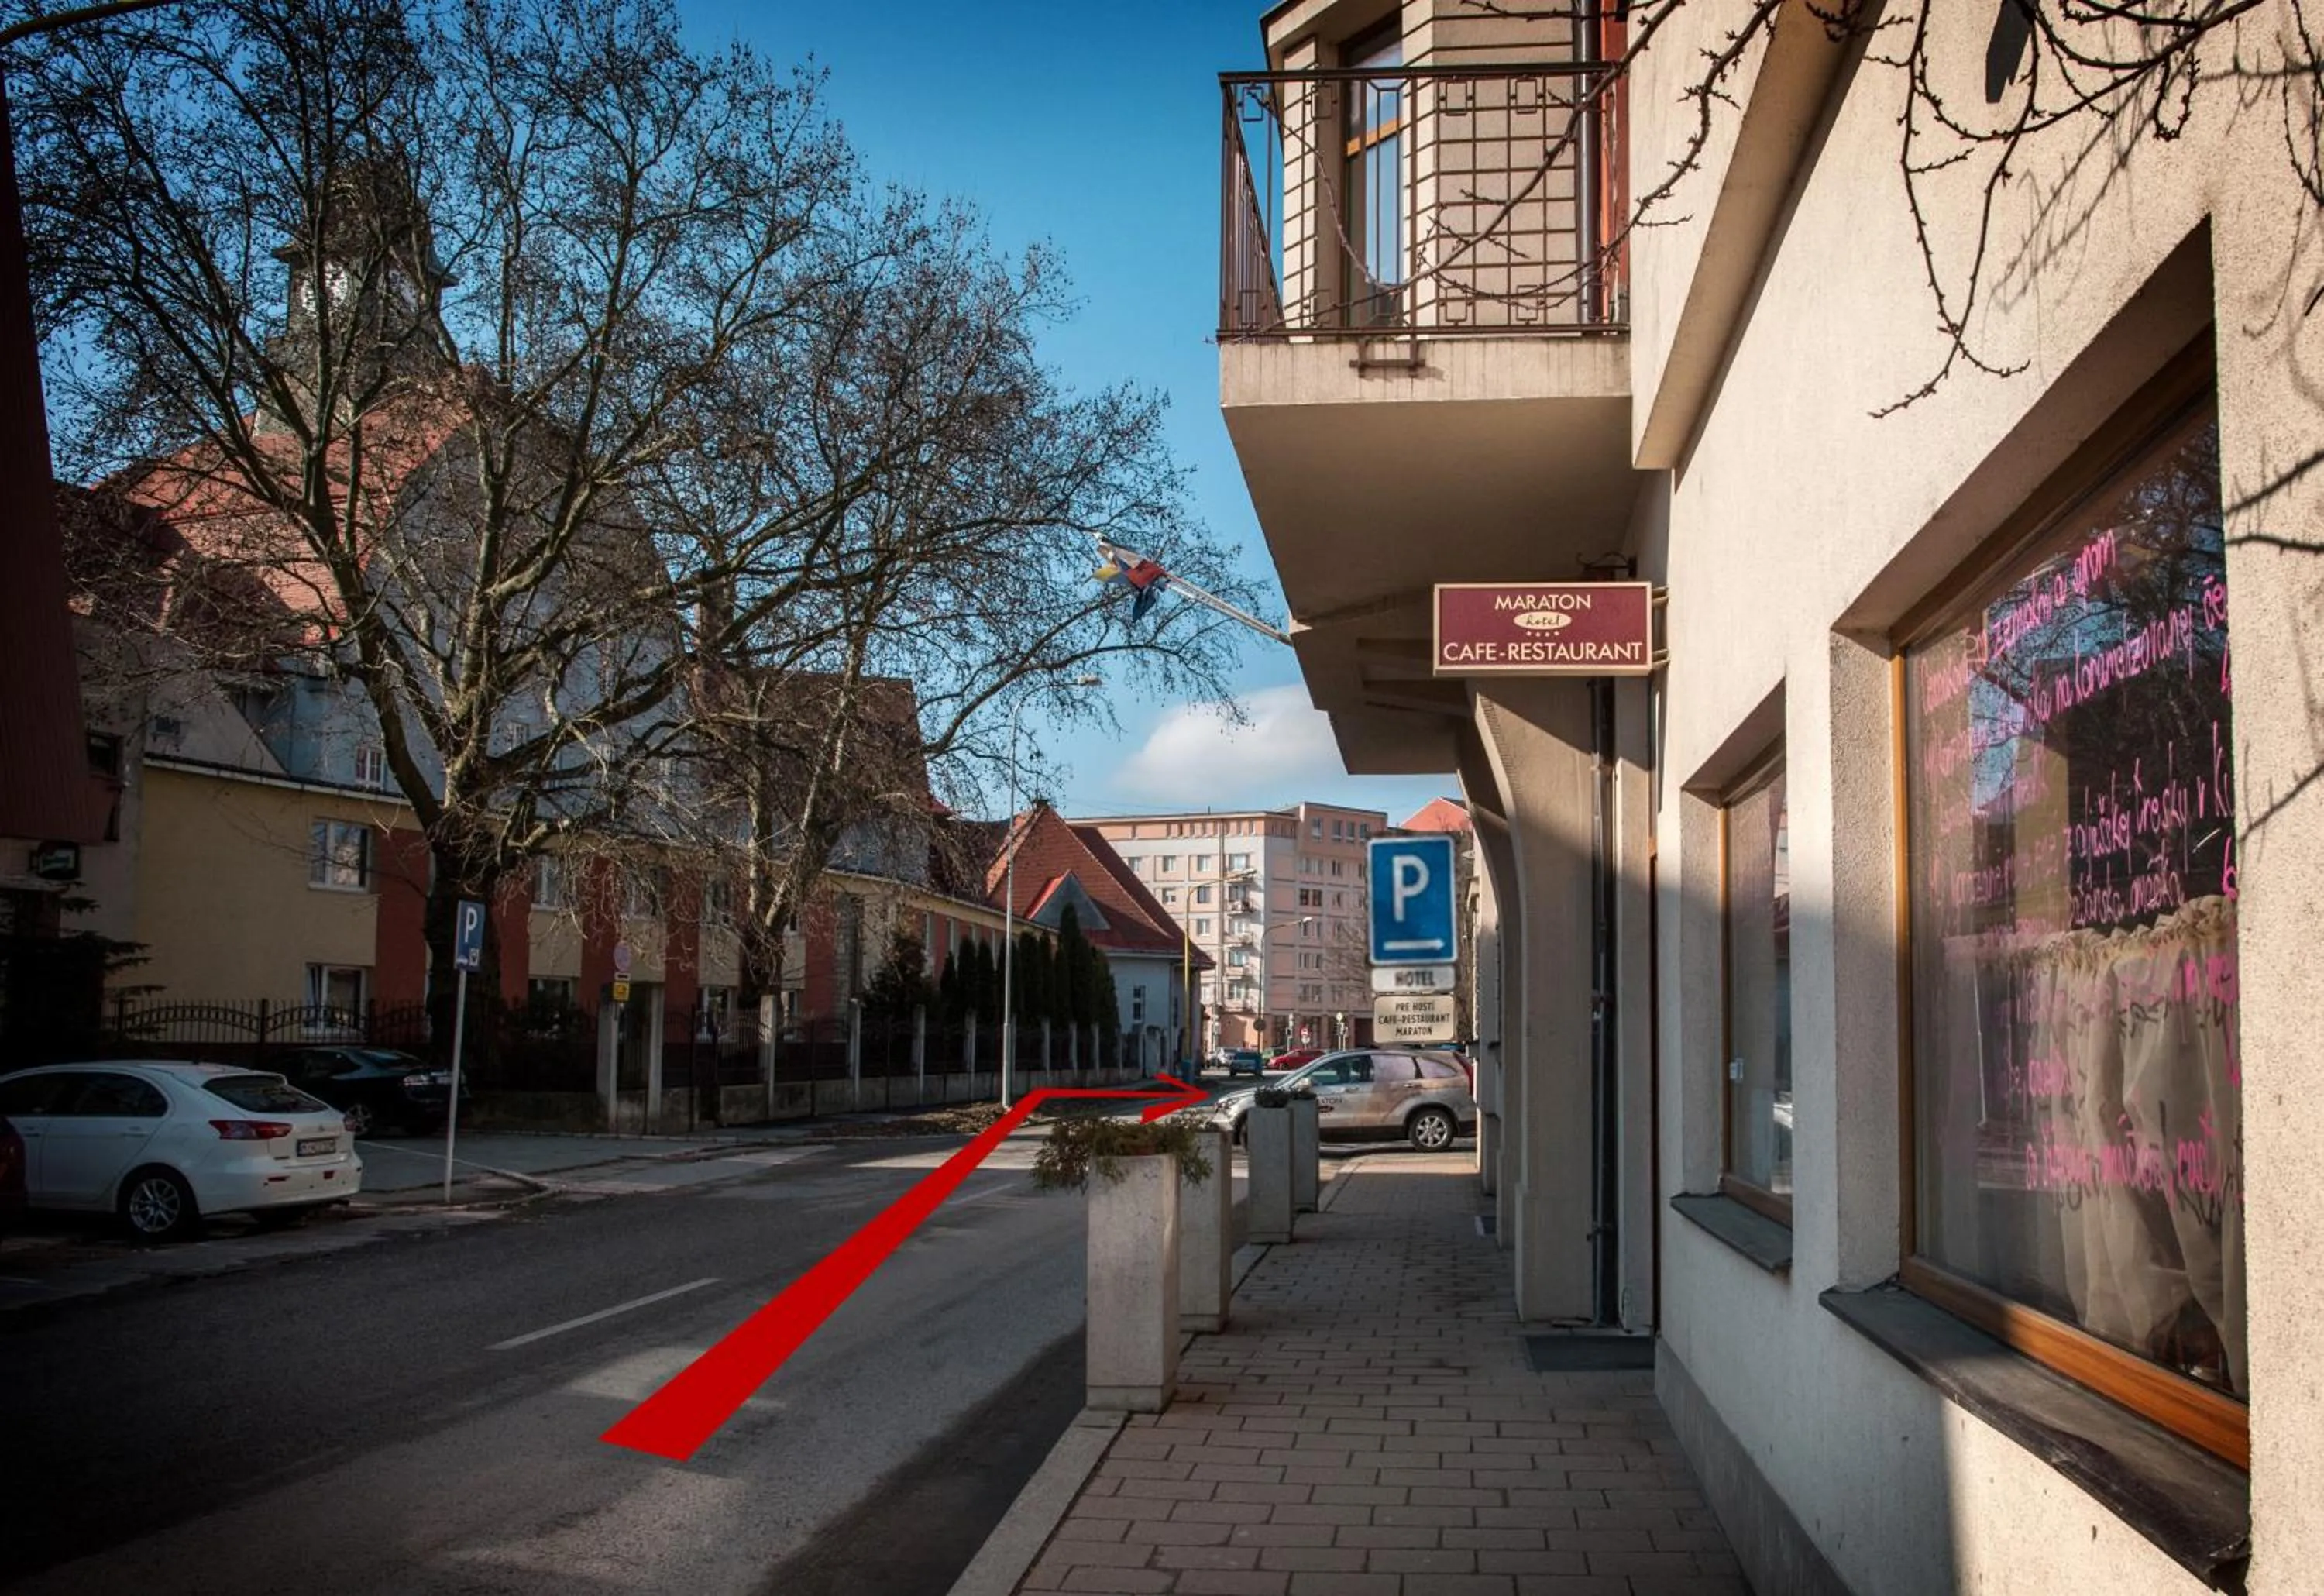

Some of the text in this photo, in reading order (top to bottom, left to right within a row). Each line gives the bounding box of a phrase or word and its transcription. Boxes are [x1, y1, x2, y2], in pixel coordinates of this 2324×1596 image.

[1495, 594, 1591, 610] MARATON
[1525, 614, 1559, 626] hotel
[1443, 642, 1643, 661] CAFE-RESTAURANT
[1393, 855, 1430, 922] P
[464, 906, 478, 943] P
[1395, 971, 1435, 986] HOTEL
[1395, 1003, 1409, 1011] PRE
[1396, 1027, 1432, 1037] MARATON
